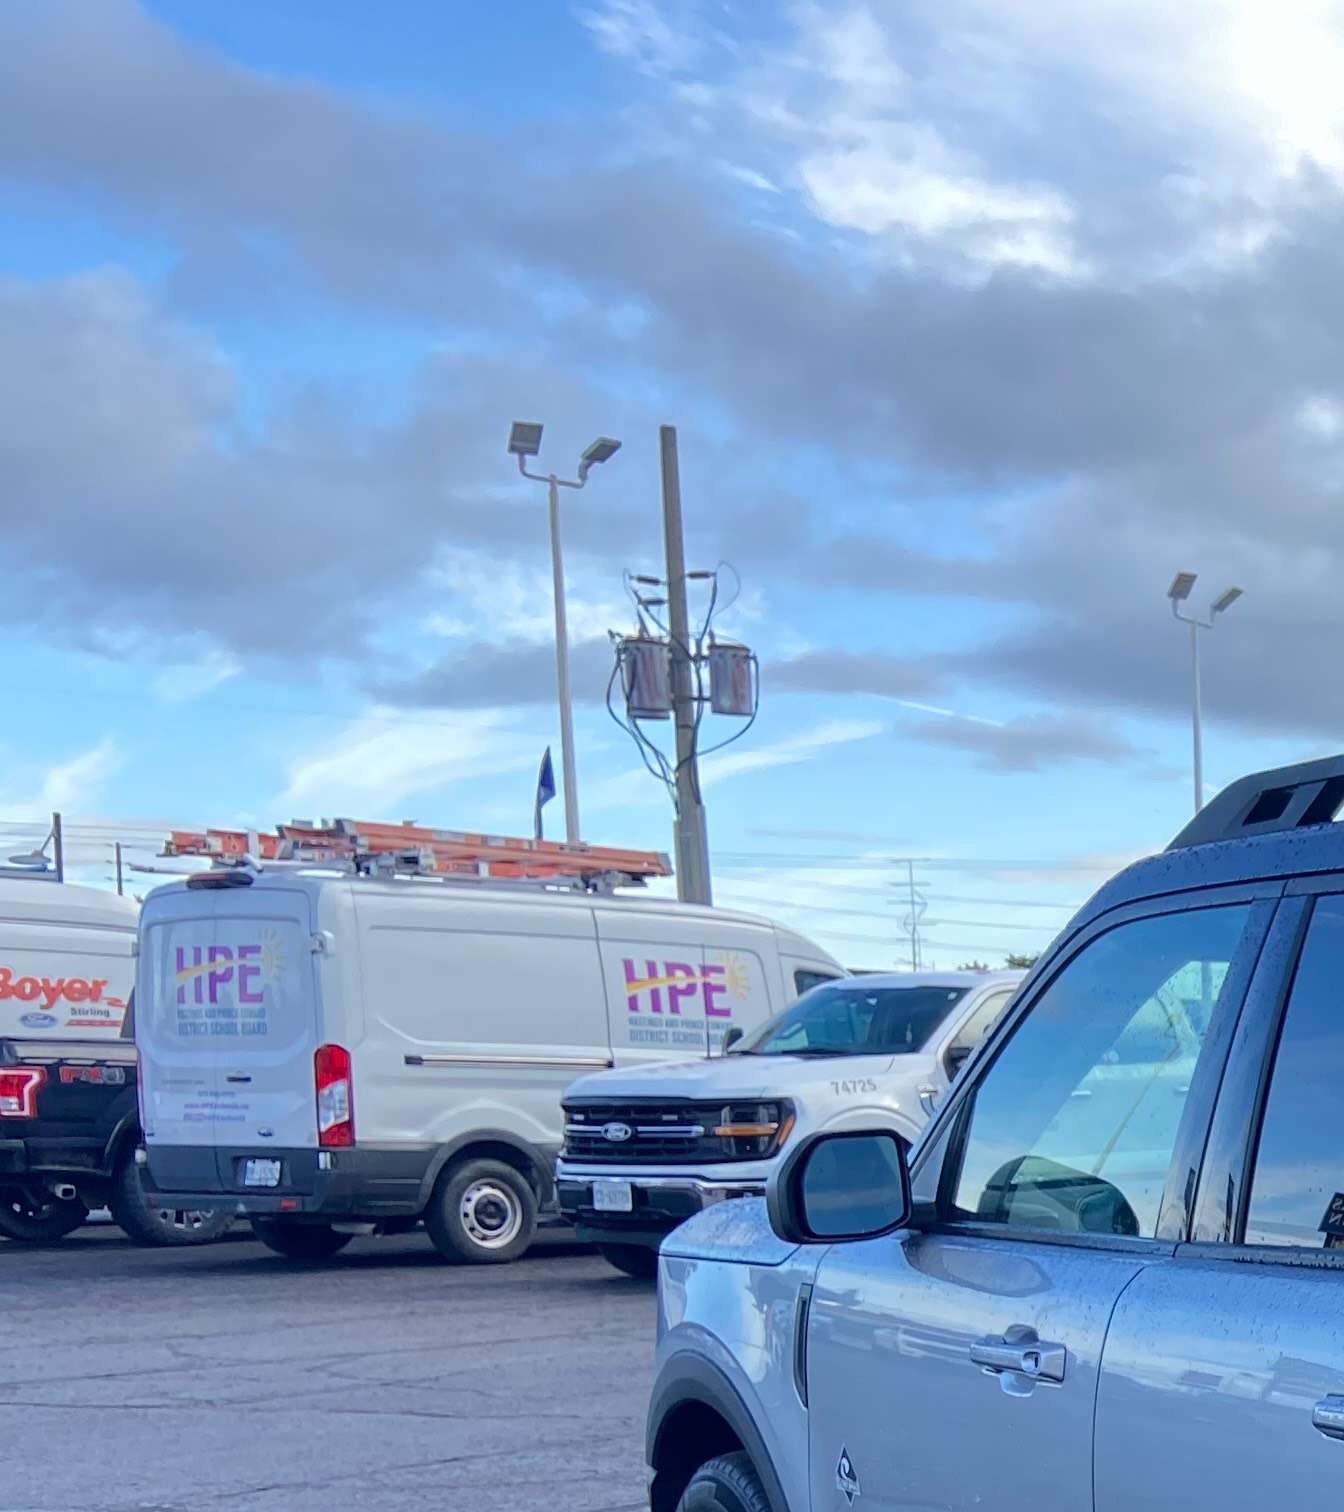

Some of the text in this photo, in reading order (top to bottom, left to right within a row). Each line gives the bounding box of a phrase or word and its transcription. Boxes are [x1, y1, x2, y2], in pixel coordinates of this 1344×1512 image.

[176, 945, 263, 1004] HPE
[622, 958, 731, 1017] HPE
[70, 1007, 110, 1018] Stirling
[630, 1030, 669, 1043] DISTRICT
[672, 1031, 704, 1046] SCHOOL
[830, 1079, 878, 1096] 74725
